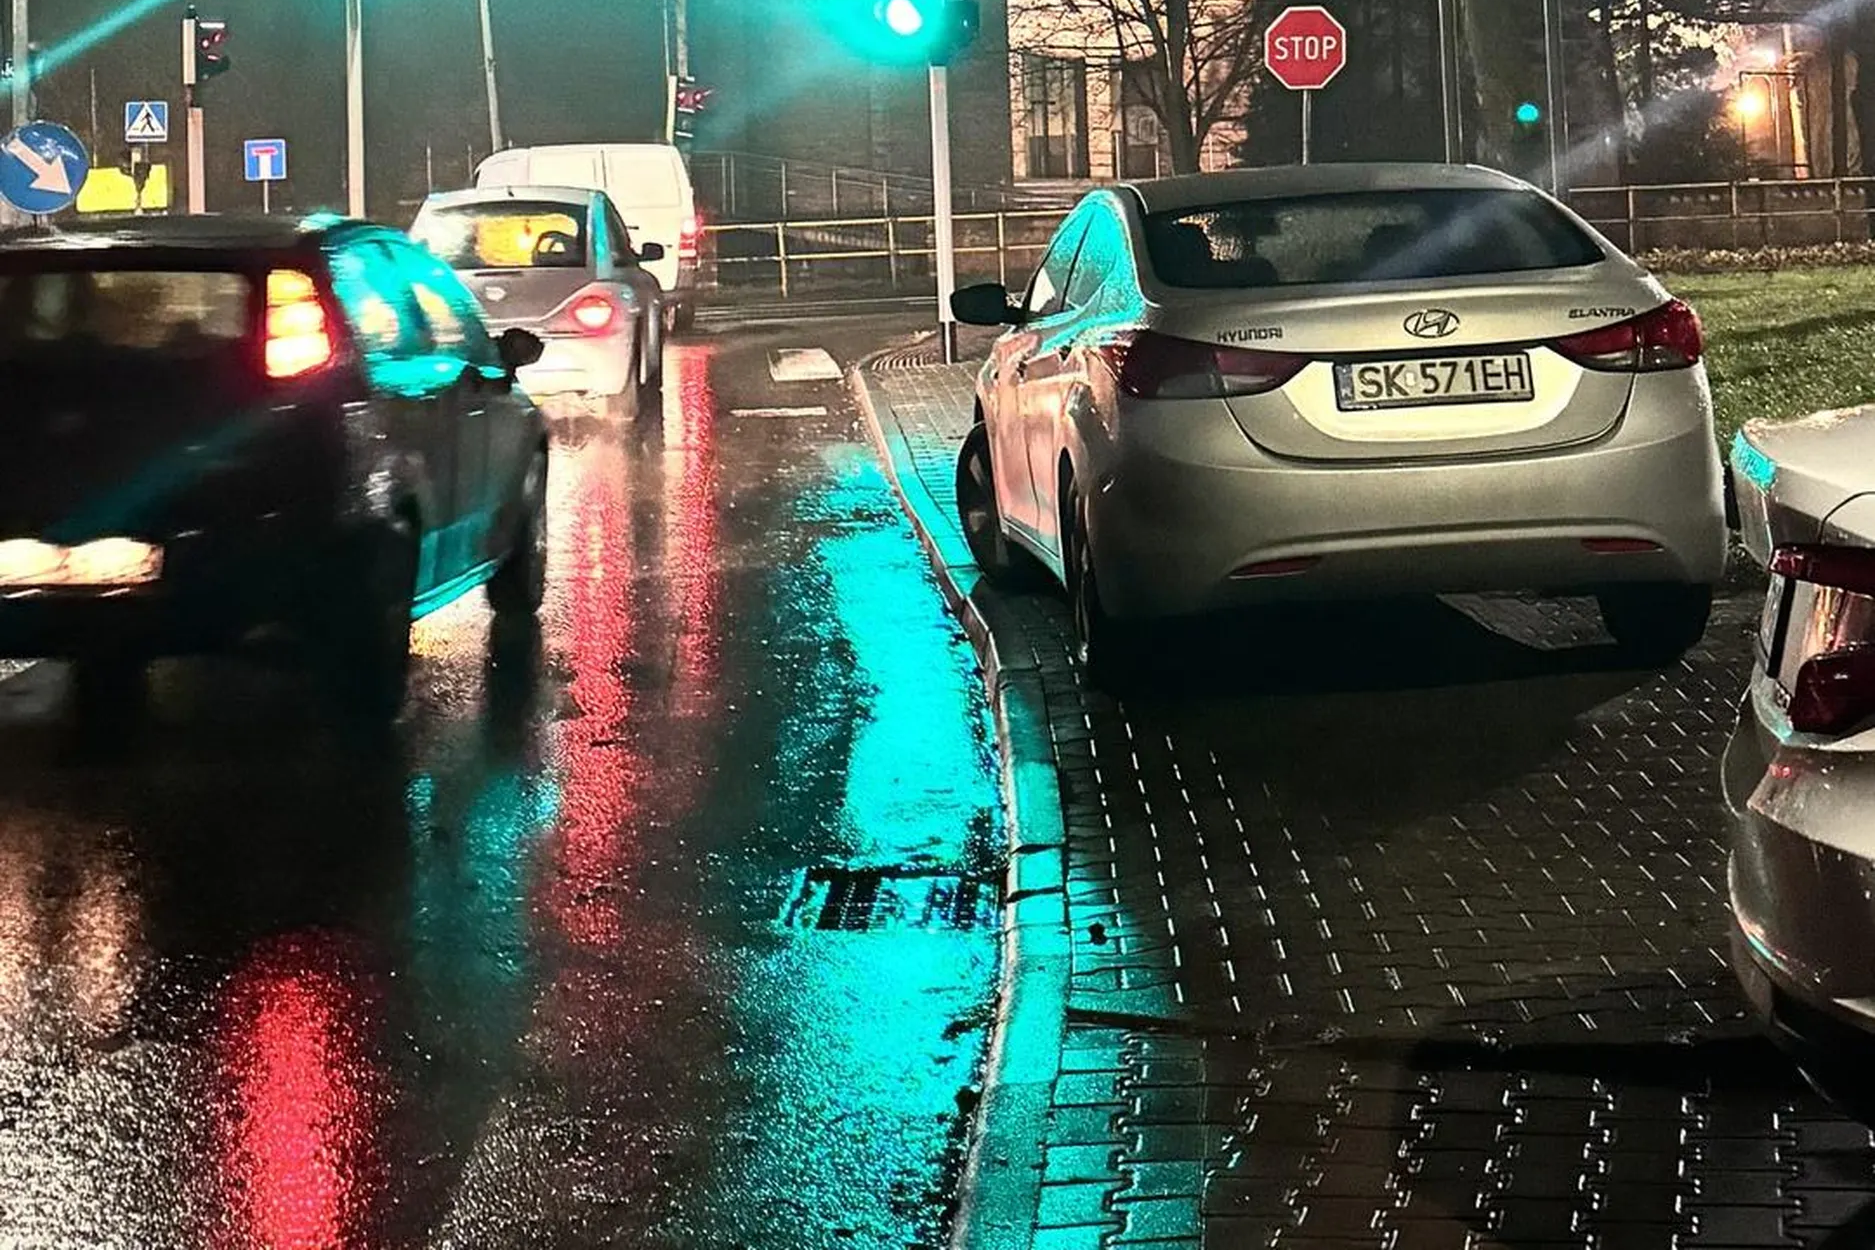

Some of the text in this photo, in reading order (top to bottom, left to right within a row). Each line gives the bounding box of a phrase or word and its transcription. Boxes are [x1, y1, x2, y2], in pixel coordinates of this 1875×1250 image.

[1274, 36, 1337, 61] STOP
[1568, 306, 1636, 319] ELANTRA
[1217, 327, 1283, 342] HYUNDAI
[1357, 363, 1410, 398] SK
[1419, 357, 1526, 394] 571EH
